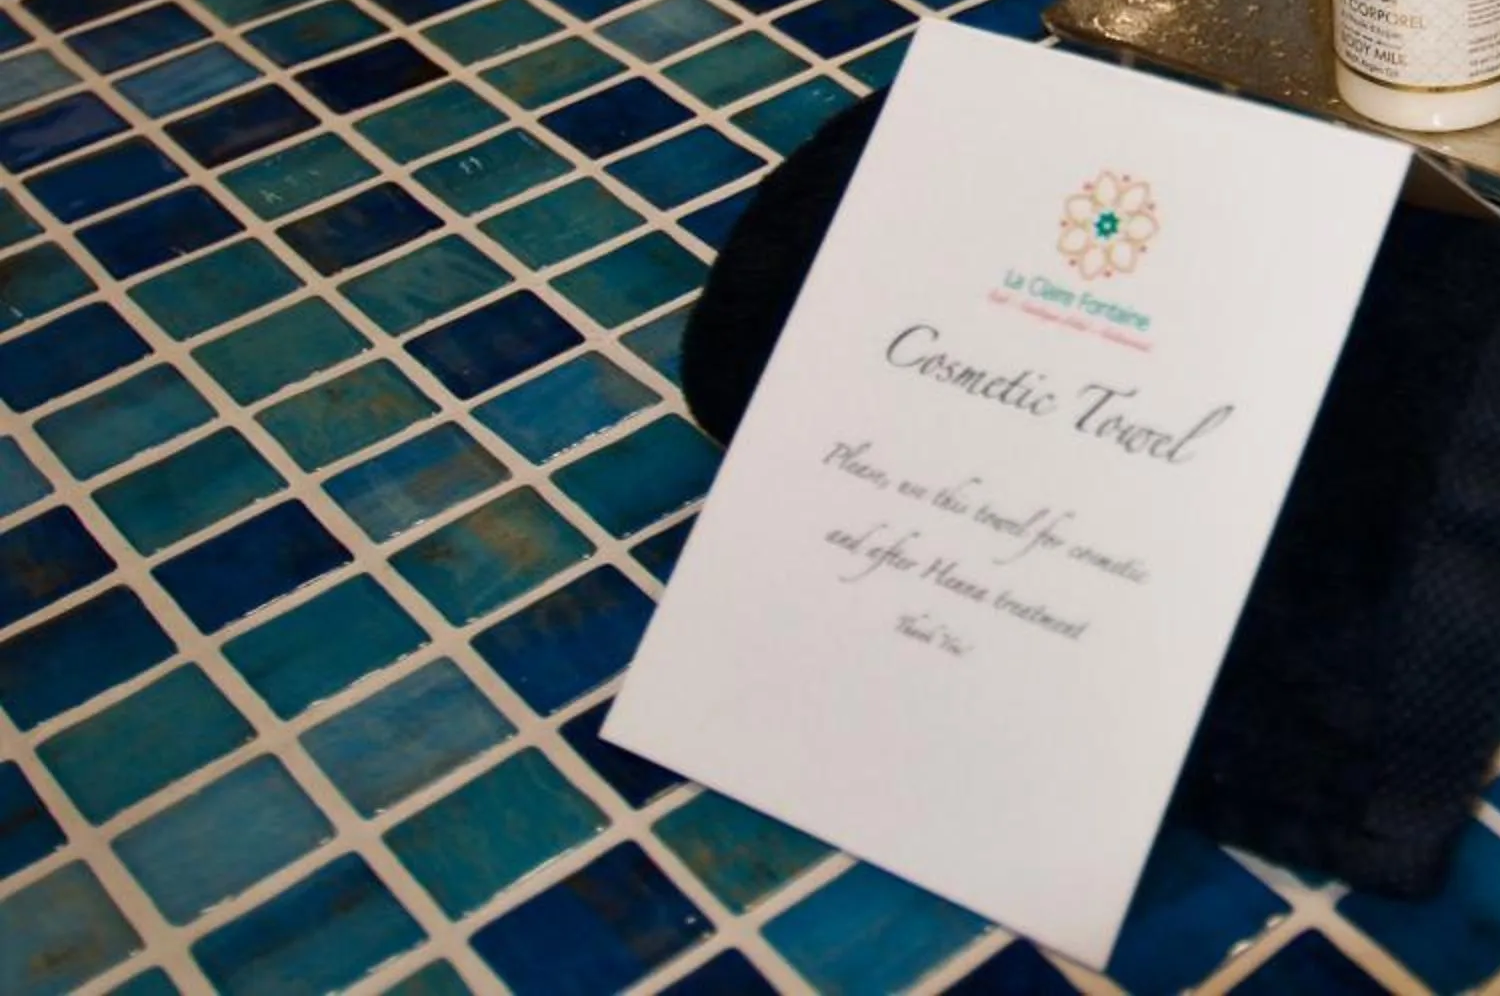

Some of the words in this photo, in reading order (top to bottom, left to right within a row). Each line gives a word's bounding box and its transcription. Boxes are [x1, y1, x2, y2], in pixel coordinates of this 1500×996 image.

[1374, 47, 1408, 66] MILK
[885, 324, 1057, 417] Cosmetic
[1073, 382, 1235, 464] Towel
[824, 522, 888, 552] and
[972, 504, 1050, 538] towel
[838, 531, 920, 583] after
[991, 589, 1091, 641] treatment
